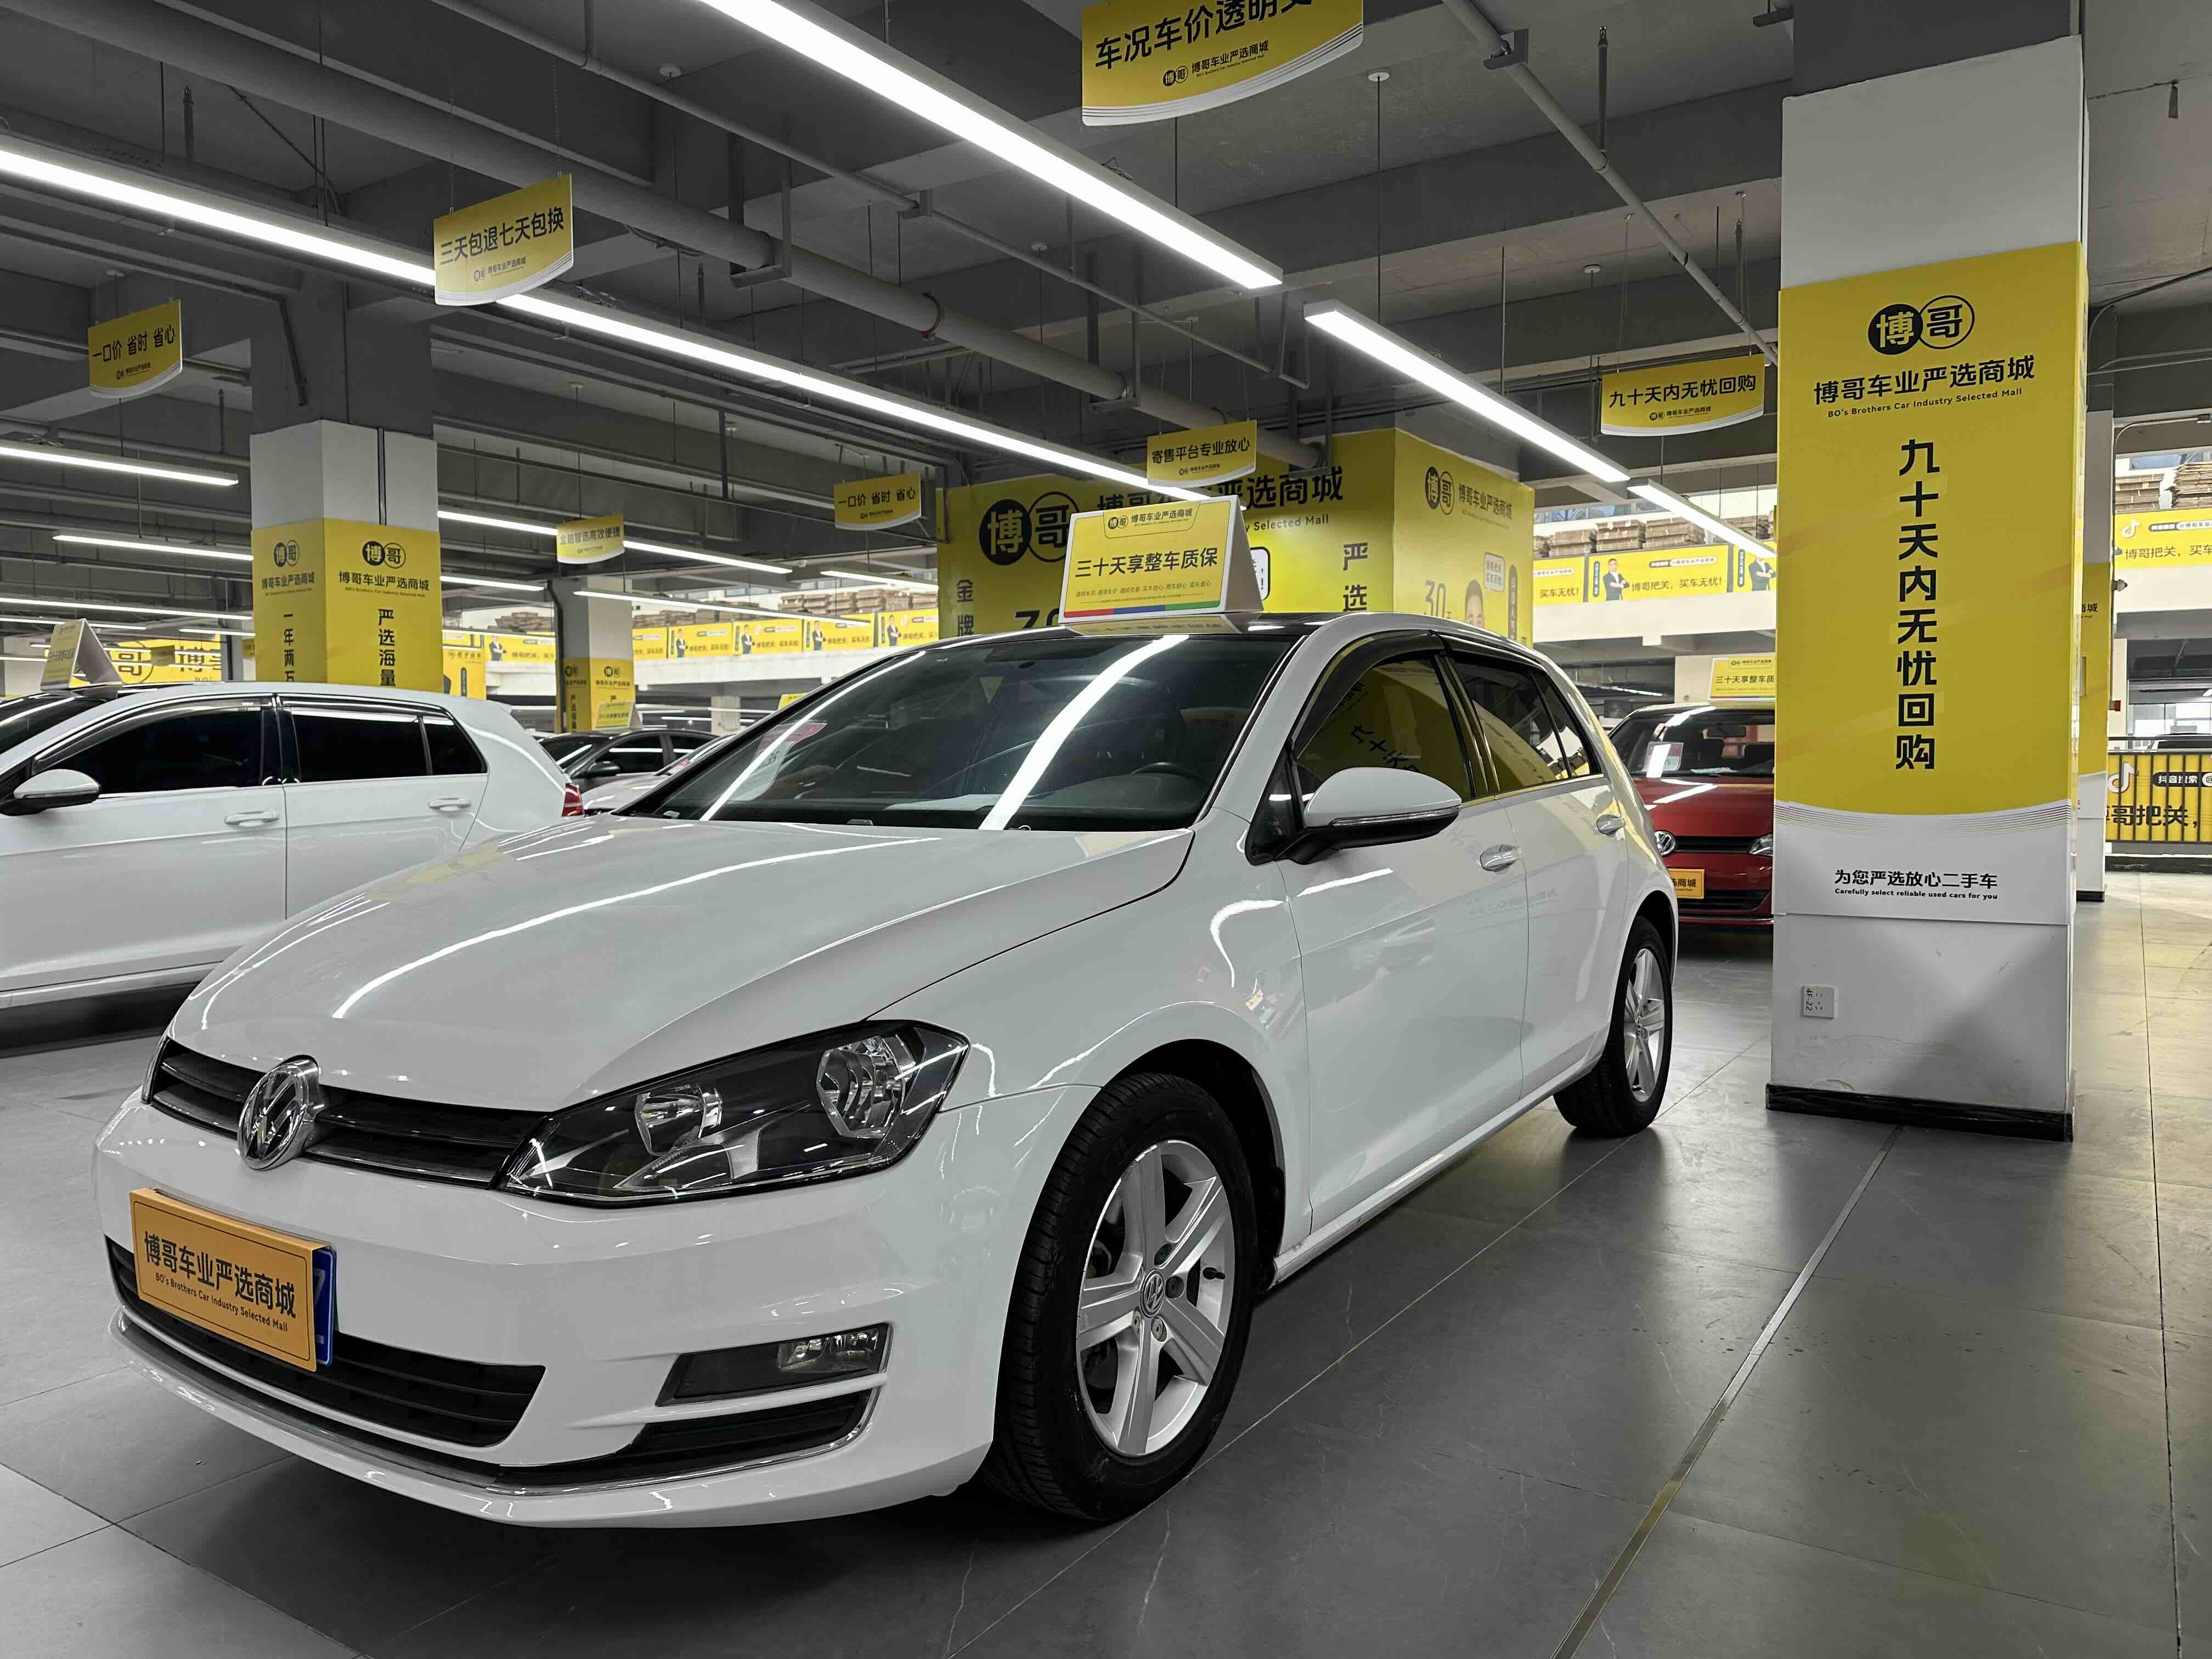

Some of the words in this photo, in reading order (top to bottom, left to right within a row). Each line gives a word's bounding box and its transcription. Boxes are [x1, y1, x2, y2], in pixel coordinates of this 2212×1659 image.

[1192, 40, 1269, 74] 博哥车业严选商城
[1164, 67, 1187, 86] 博哥
[440, 206, 564, 264] 三天包退七天包换
[1872, 300, 1968, 351] 博哥
[92, 338, 122, 362] 一口价
[127, 331, 148, 356] 省时
[154, 324, 175, 348] 省心
[1609, 374, 1756, 408] 九十天内无忧回购
[1814, 354, 2035, 405] 博哥车业严选商城
[1828, 409, 1848, 417] BO's
[1852, 403, 1891, 415] Brothers
[1914, 396, 1953, 408] Industry
[1956, 391, 1998, 402] Selected
[2002, 387, 2022, 397] Mall
[1152, 437, 1250, 464] 寄售平台专业放心
[838, 493, 866, 507] 一口价
[872, 489, 891, 505] 省时
[896, 487, 916, 501] 省心
[1426, 470, 1452, 511] 博哥
[984, 499, 1073, 560] 博哥
[1254, 516, 1301, 531] Selected
[1305, 514, 1329, 524] Mall
[364, 543, 403, 566] 博哥
[1075, 547, 1218, 578] 三十天享整车质保
[338, 571, 430, 591] 博哥车业严选商城
[1896, 439, 1940, 769] 九十天内无忧回购
[378, 608, 396, 686] 严选海量
[1834, 869, 1998, 889] 为您严选放心二手车
[144, 1231, 296, 1318] 博哥车业严选商城
[155, 1272, 170, 1285] BO's
[171, 1279, 198, 1297] Brothers
[198, 1290, 210, 1301] Car
[211, 1295, 239, 1315] Industry
[240, 1307, 270, 1325] Selected
[273, 1320, 288, 1332] Mall
